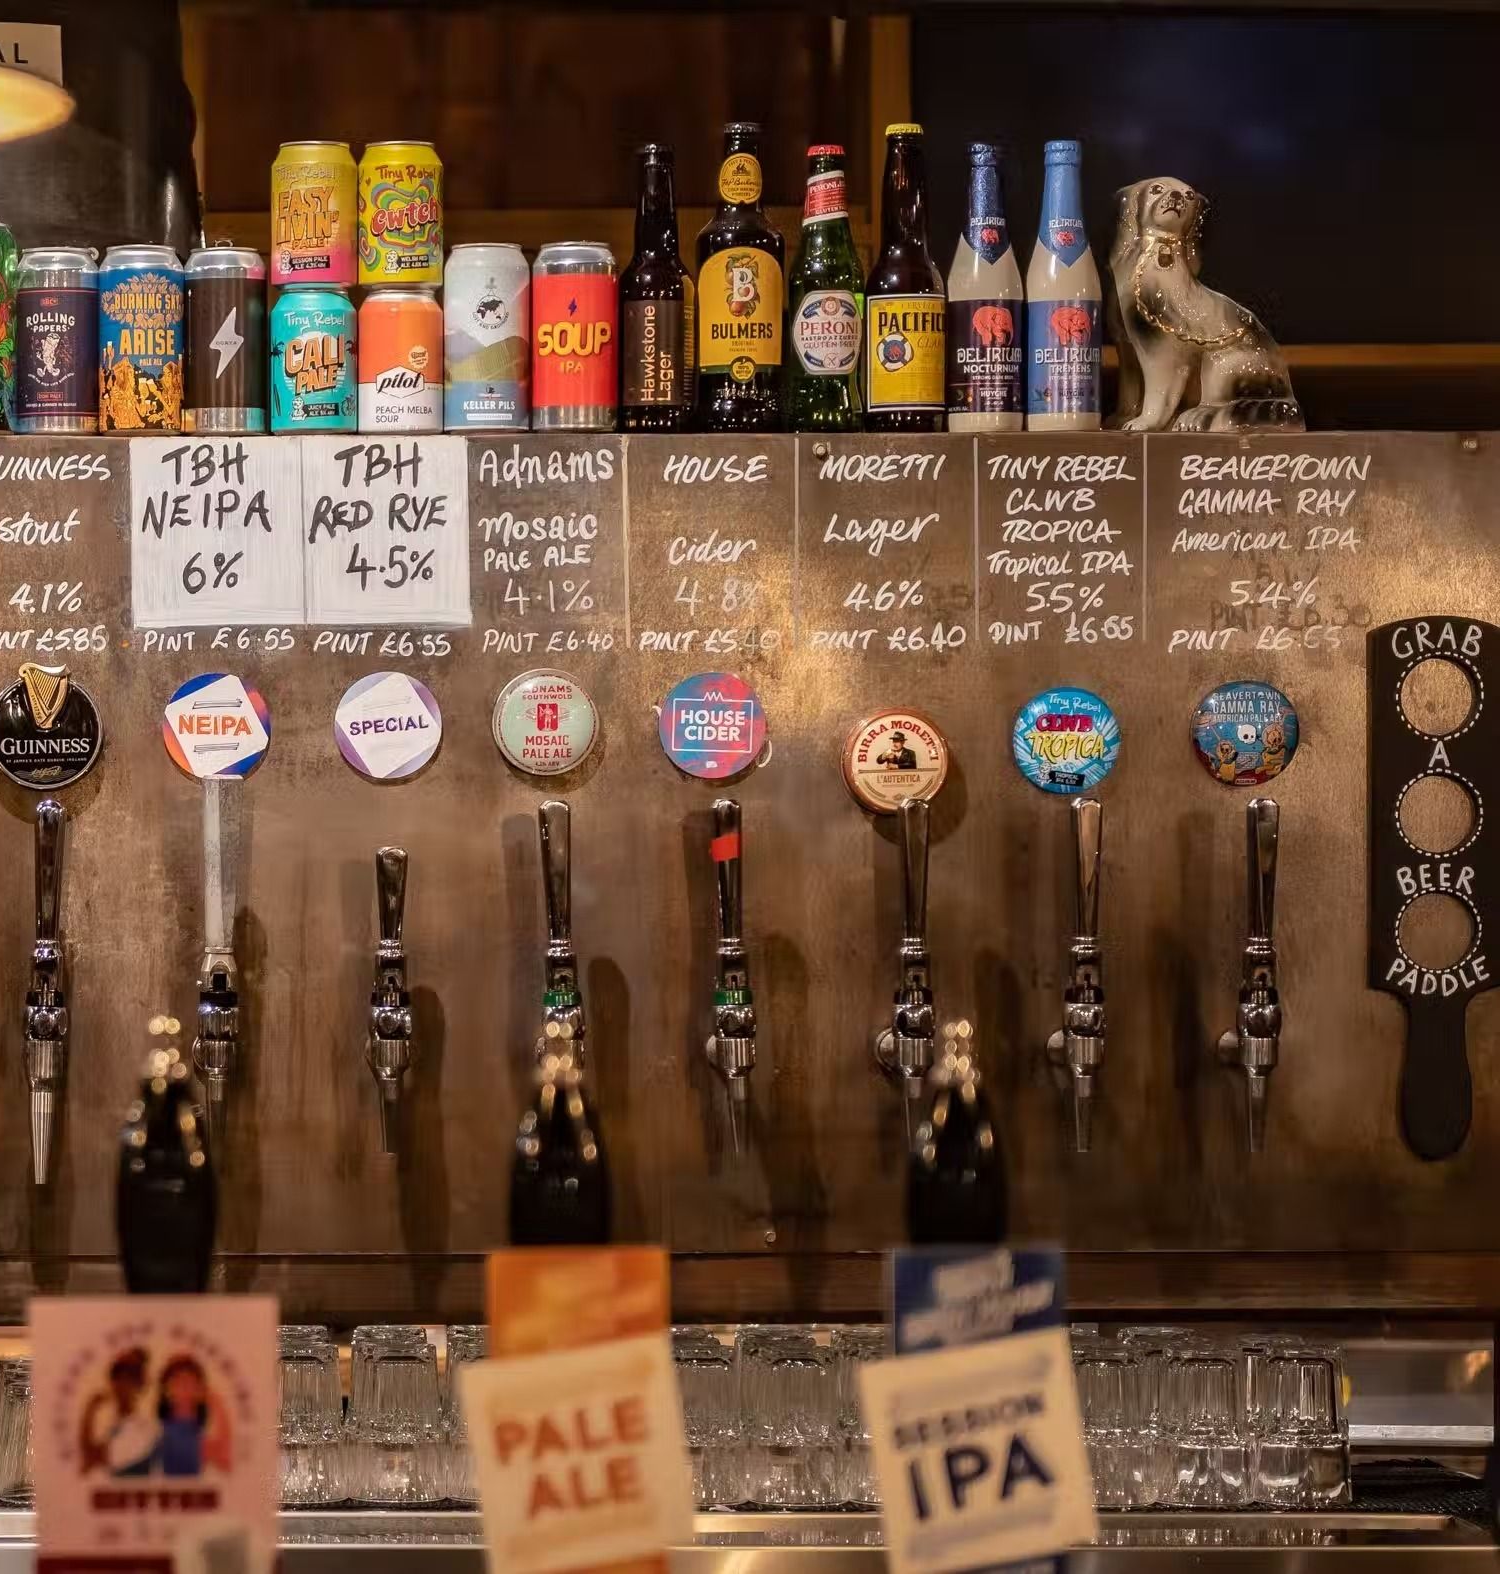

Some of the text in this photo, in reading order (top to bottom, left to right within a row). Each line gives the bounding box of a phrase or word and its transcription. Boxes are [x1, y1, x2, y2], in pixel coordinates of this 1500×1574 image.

[278, 186, 335, 217] EASY
[114, 293, 162, 310] BURNING
[26, 311, 76, 328] ROLLING
[284, 312, 345, 330] Tiny Rebel
[711, 322, 773, 340] BULMERS
[800, 320, 859, 336] PERONI
[119, 328, 175, 356] ARISE
[537, 321, 612, 357] SOUP
[640, 304, 656, 402] Hawkstone
[285, 335, 345, 373] CALI
[957, 347, 1022, 363] DELIRIUM
[1035, 348, 1100, 364] DELIRIUM
[1050, 364, 1091, 373] TREMENS
[295, 367, 337, 396] PALE
[377, 372, 424, 394] pilot
[657, 351, 675, 401] Lager
[963, 364, 1019, 374] NOCTURNUM
[375, 405, 433, 415] PEACH MELBA
[375, 415, 399, 424] SOUR
[463, 401, 516, 411] KELLER PILS
[162, 442, 249, 487] TBH
[334, 442, 423, 488] TBH
[478, 443, 615, 489] Adnams
[663, 454, 769, 484] HOUSE
[819, 454, 947, 483] MORETTI
[987, 455, 1136, 483] TINY REBEL
[1179, 453, 1372, 483] BEAVERTOWN
[1005, 488, 1097, 516] CLWB
[1177, 488, 1357, 518] GAMMA RAY
[308, 493, 448, 544] RED RYE
[1001, 519, 1122, 545] TROPICA
[668, 528, 757, 566] Cider
[823, 513, 940, 557] Lager
[1171, 525, 1362, 554] American IPA
[182, 550, 244, 595] 6%
[345, 543, 435, 592] 4.5%
[484, 544, 592, 572] PALE ALE
[986, 549, 1135, 583] Tropical IPA
[8, 581, 83, 613] 4.1%
[504, 577, 594, 616] 4.1%
[843, 579, 924, 613] 4.6%
[1025, 581, 1106, 614] 5.5%
[1229, 575, 1320, 609] 5.4%
[211, 628, 295, 651] £6.55
[379, 631, 451, 657] £6.55
[482, 629, 614, 654] PINT £6.40
[886, 622, 966, 653] £6.40
[1167, 626, 1241, 654] PINT
[1391, 620, 1484, 660] GRAB
[680, 709, 746, 726] HOUSE
[1212, 701, 1281, 713] GAMMA RAY
[178, 713, 253, 736] NEIPA
[349, 714, 430, 737] SPECIAL
[684, 725, 740, 742] CIDER
[0, 737, 90, 755] GUINNESS
[522, 748, 572, 759] PALE ALE
[525, 735, 569, 746] MOSAIC
[857, 719, 940, 764] BIRRA MORETTI
[1026, 732, 1106, 765] TROPICA
[1428, 740, 1451, 768] A
[1396, 863, 1476, 896] BEER
[1385, 956, 1491, 997] PADDLE
[491, 1398, 649, 1471] PALE
[525, 1455, 641, 1521] ALE
[904, 1431, 1055, 1522] IPA
